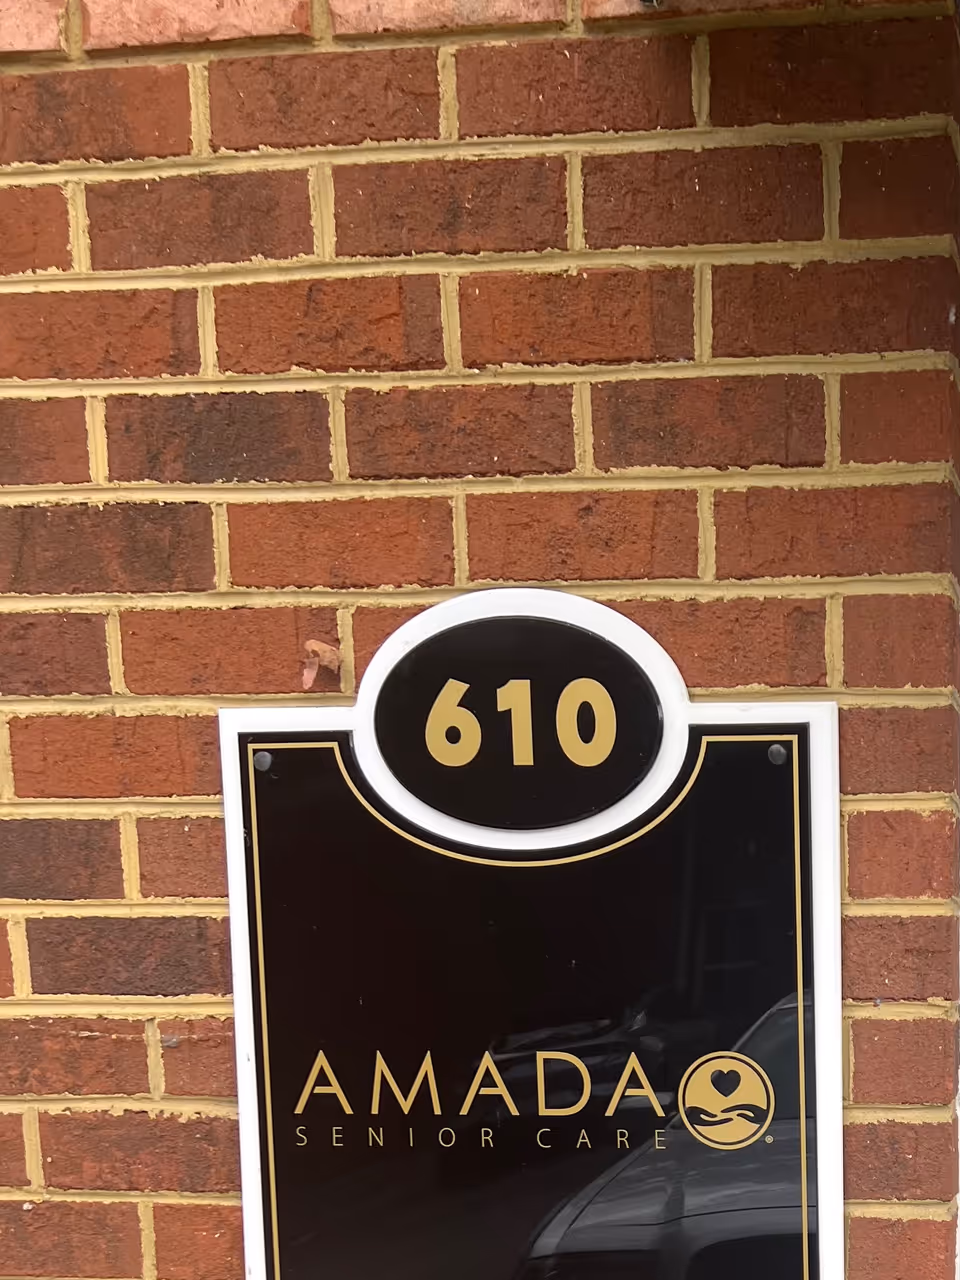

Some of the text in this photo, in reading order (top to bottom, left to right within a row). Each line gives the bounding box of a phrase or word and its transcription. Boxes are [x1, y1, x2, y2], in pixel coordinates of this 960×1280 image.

[424, 677, 617, 767] 610
[293, 1049, 666, 1117] AMADA
[294, 1126, 667, 1149] SENIOR CARE
